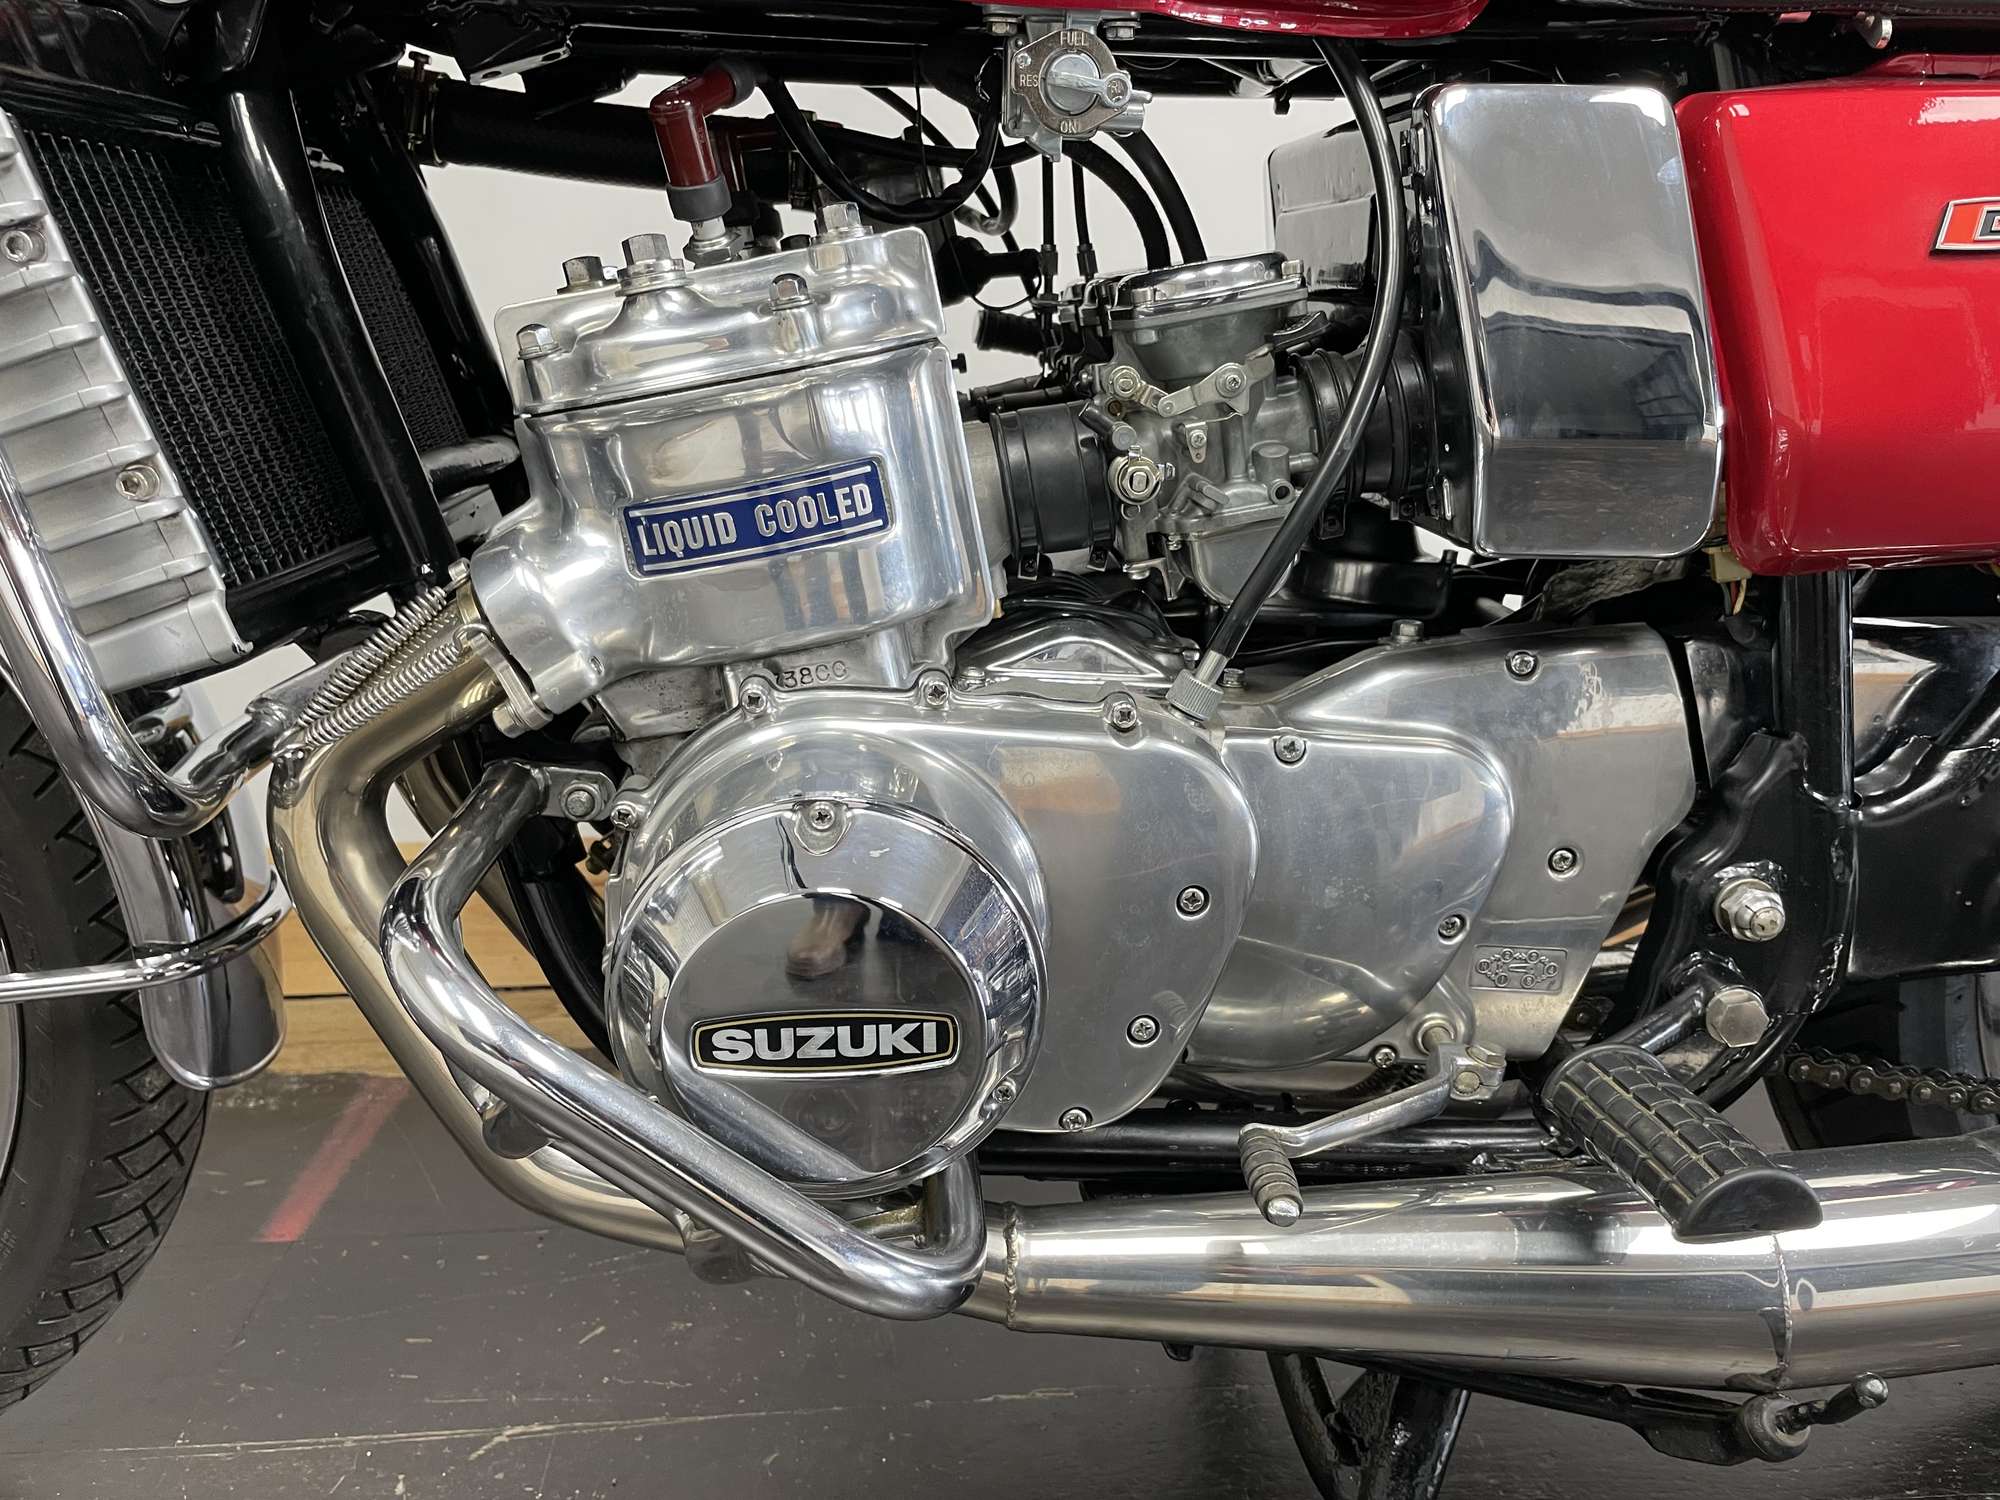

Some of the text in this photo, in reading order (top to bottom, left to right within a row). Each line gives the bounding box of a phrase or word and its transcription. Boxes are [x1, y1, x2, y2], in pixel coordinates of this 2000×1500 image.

[1060, 31, 1088, 46] FUEL
[1020, 74, 1038, 87] RES
[1060, 120, 1077, 134] ON
[636, 483, 874, 558] LIQUID COOLED
[711, 1021, 937, 1062] SUZUKI
